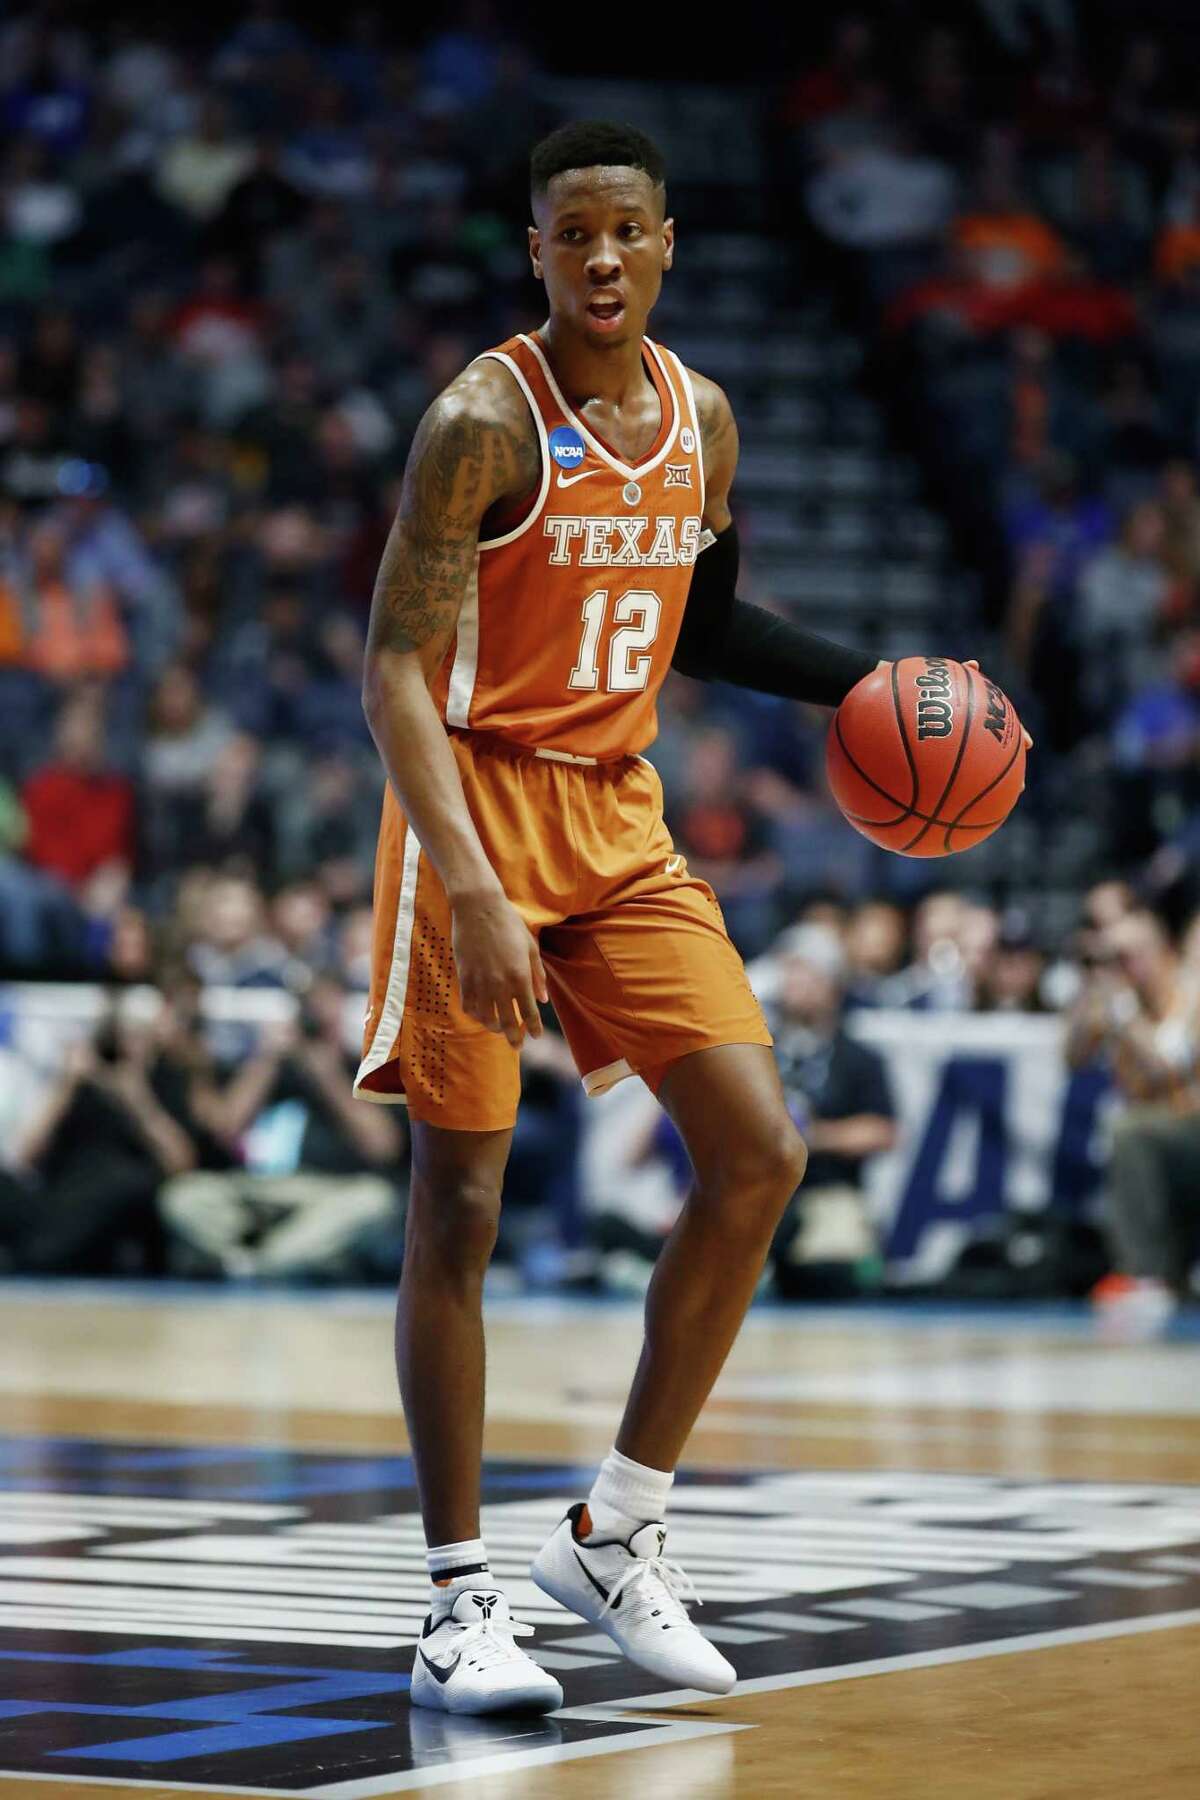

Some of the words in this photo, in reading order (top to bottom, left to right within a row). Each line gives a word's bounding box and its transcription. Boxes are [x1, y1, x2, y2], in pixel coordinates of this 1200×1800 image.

[555, 446, 584, 458] NCAA
[544, 516, 701, 566] TEXAS
[568, 590, 663, 692] 12
